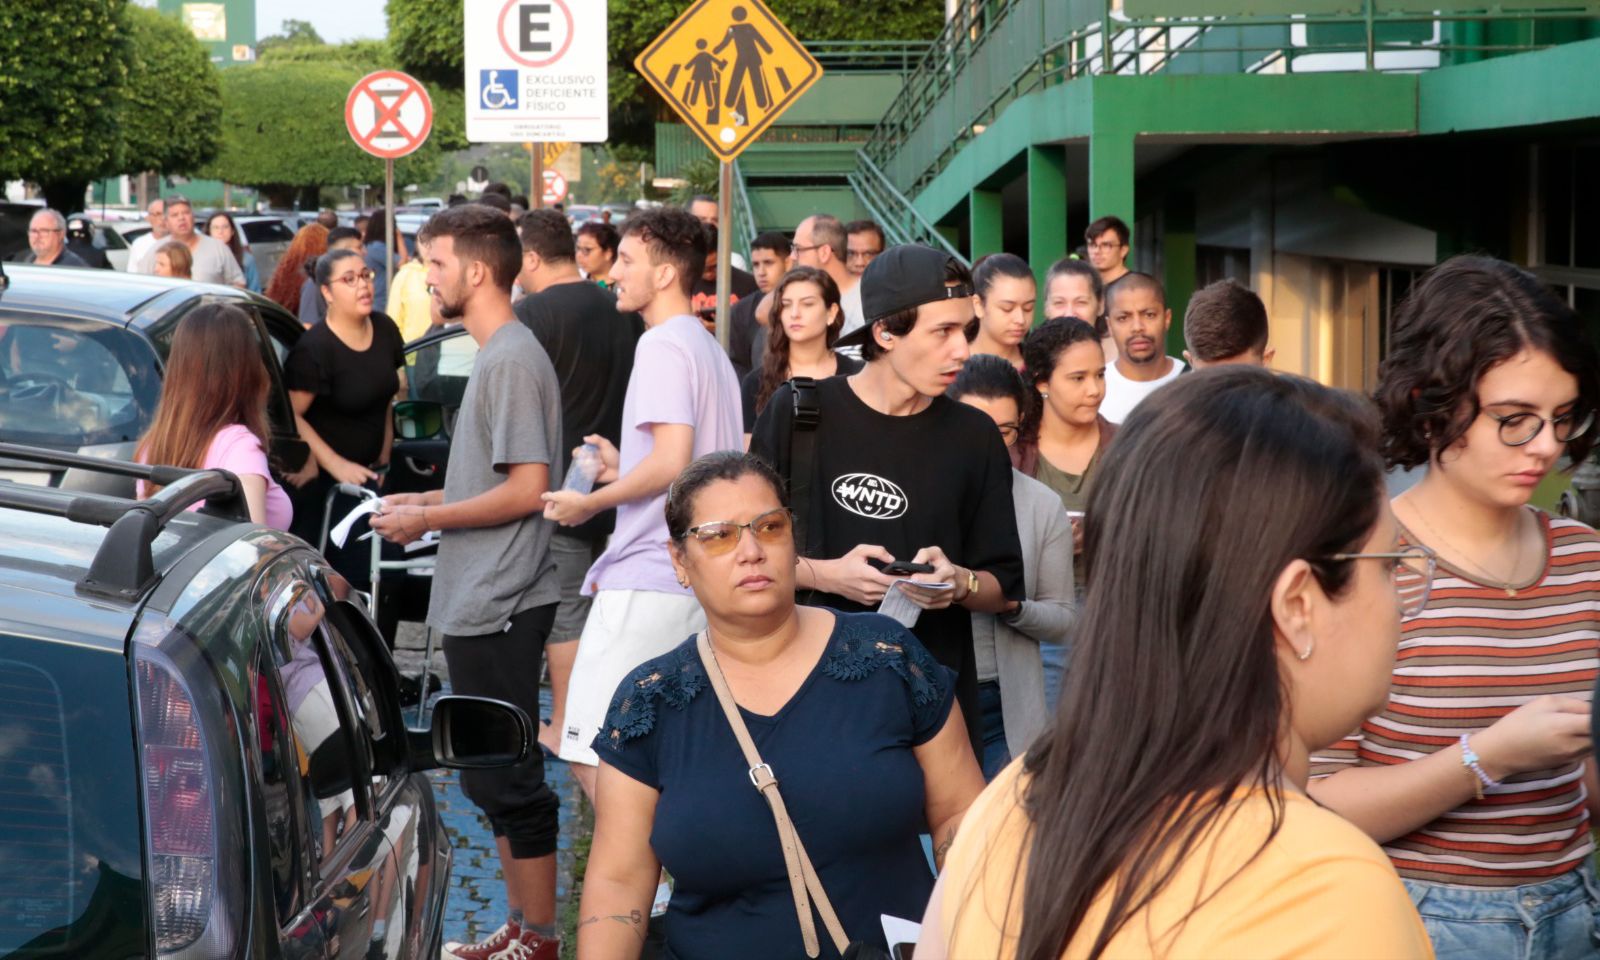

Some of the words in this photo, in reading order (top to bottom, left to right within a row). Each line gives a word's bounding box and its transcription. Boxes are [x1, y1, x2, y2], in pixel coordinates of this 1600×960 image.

[519, 4, 552, 52] E
[526, 75, 596, 85] EXCLUSIVO
[526, 88, 597, 98] DEFICIENTE
